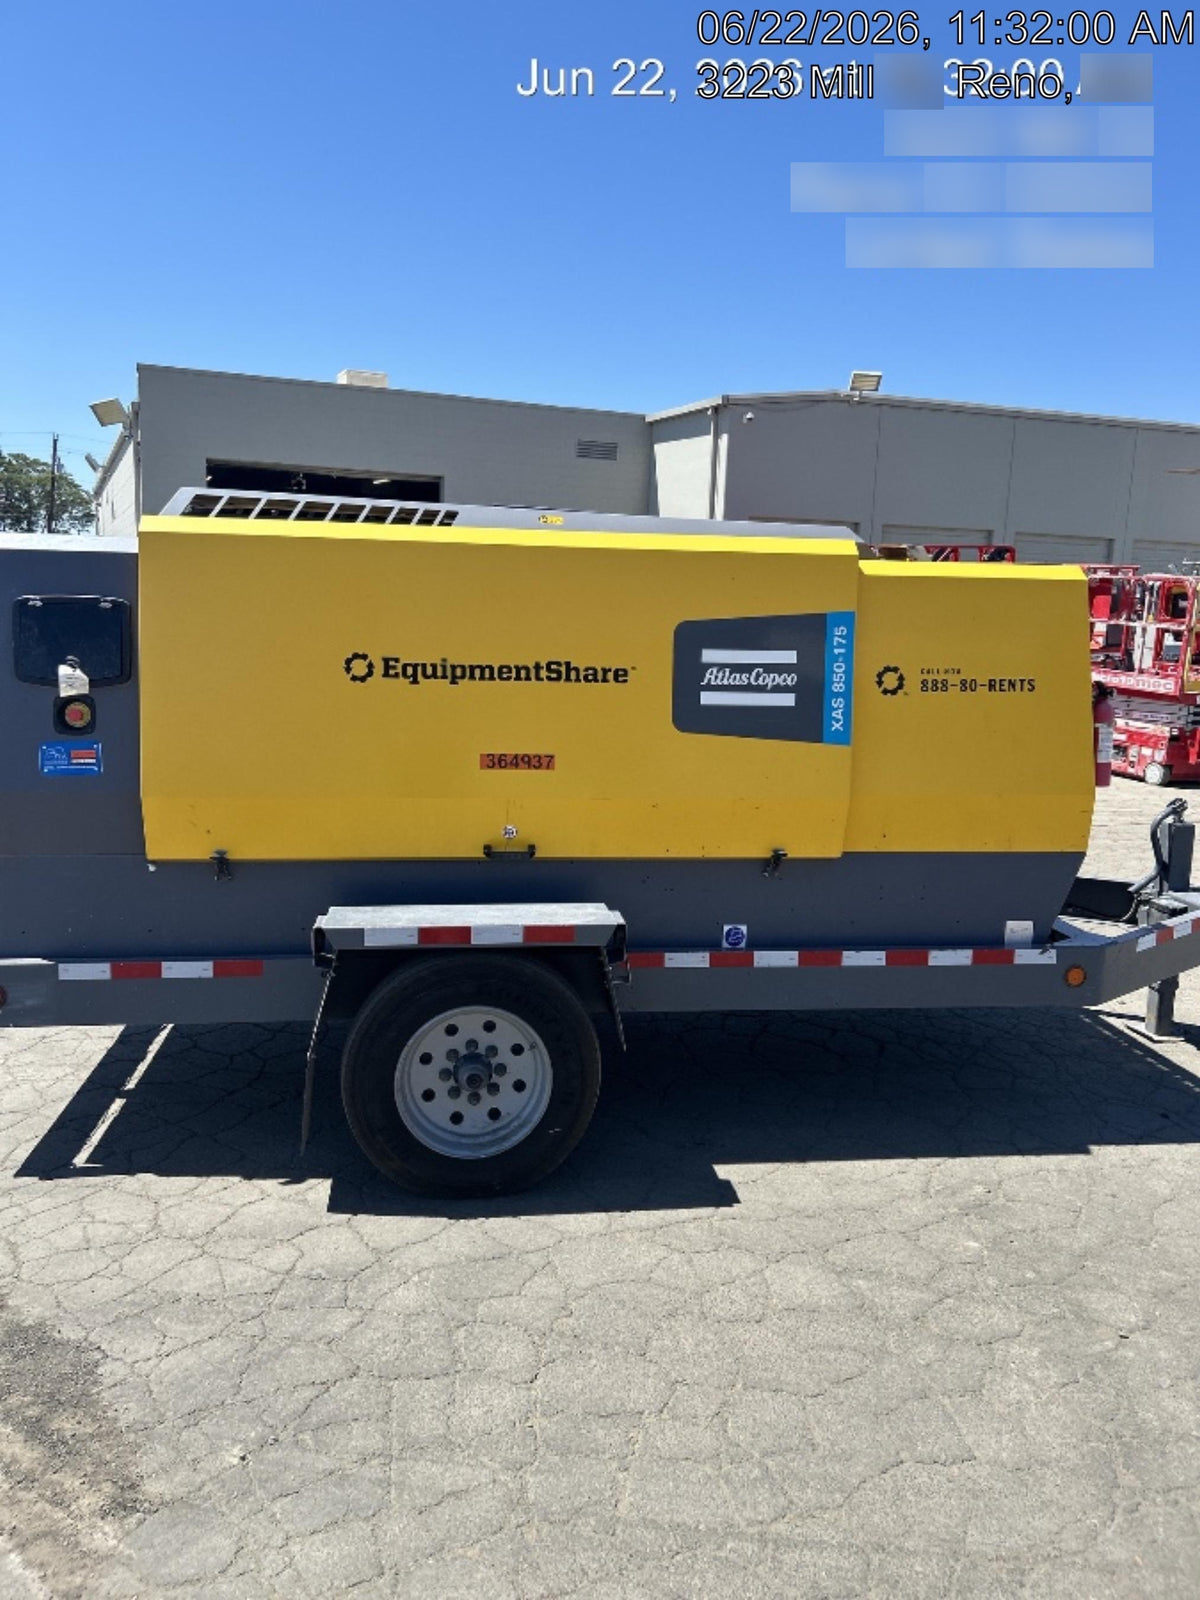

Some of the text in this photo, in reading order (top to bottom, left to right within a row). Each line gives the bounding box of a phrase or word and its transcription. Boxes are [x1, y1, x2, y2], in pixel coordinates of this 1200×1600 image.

[381, 657, 629, 685] EquipmentShare
[920, 679, 1036, 692] 888-80-RENTS
[831, 698, 845, 731] XAS
[486, 753, 555, 769] 364937
